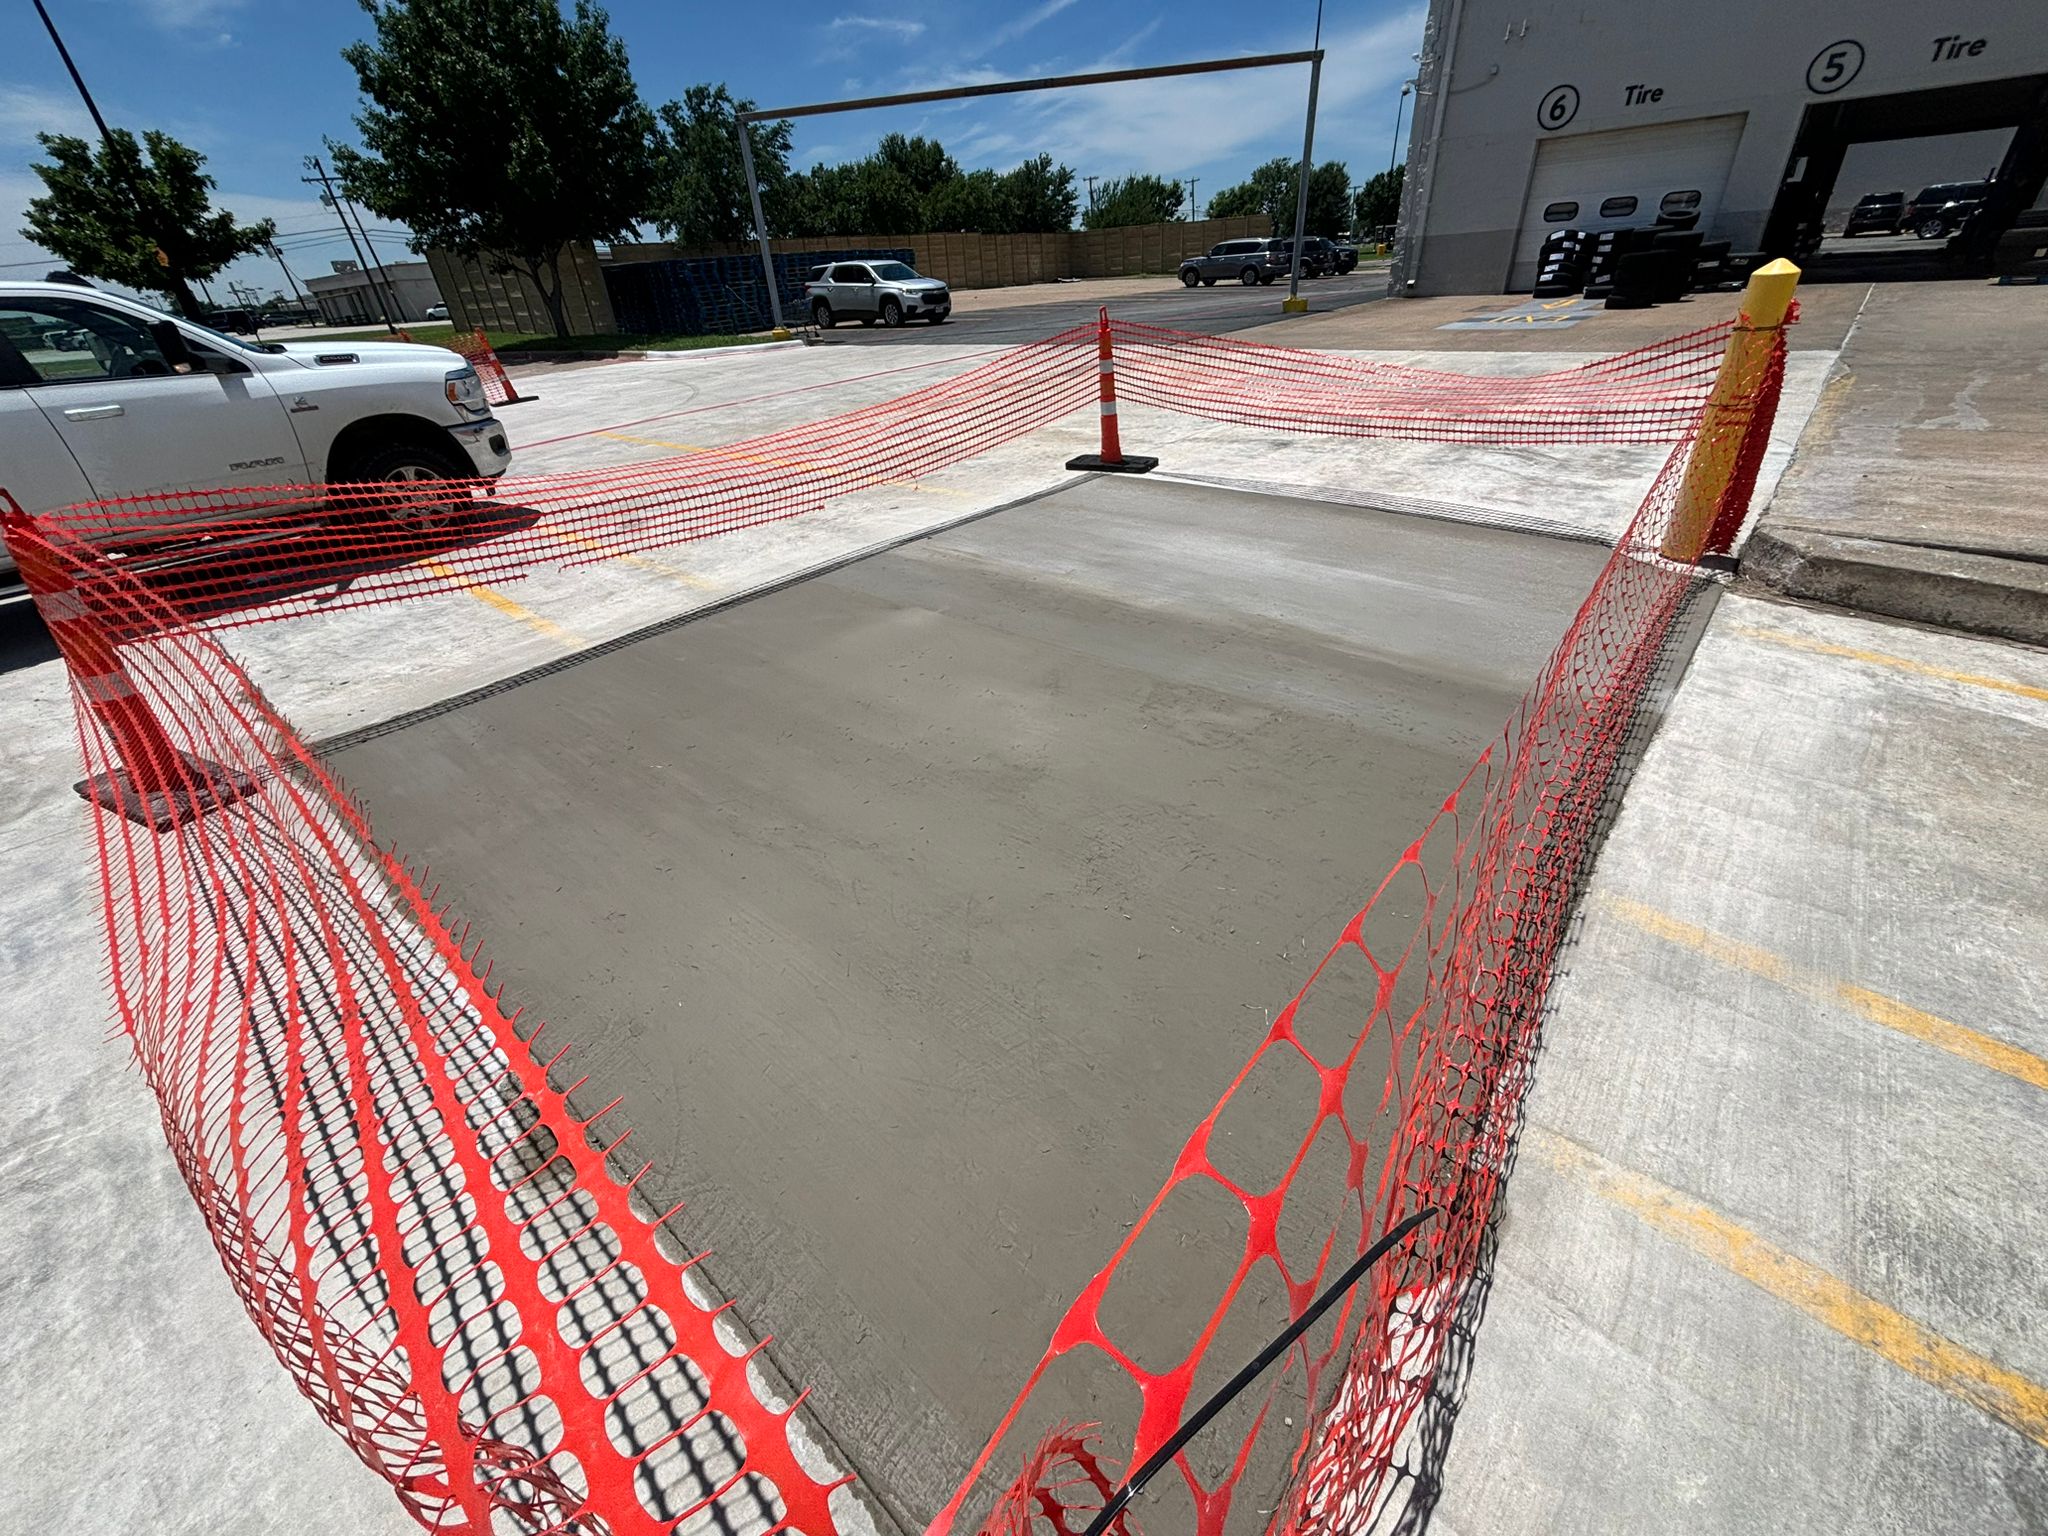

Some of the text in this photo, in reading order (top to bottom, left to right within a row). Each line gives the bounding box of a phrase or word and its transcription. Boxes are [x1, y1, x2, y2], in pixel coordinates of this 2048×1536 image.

[1931, 35, 1987, 62] Tire
[1821, 51, 1848, 83] 5
[1550, 94, 1567, 121] 6
[1624, 84, 1664, 106] Tire
